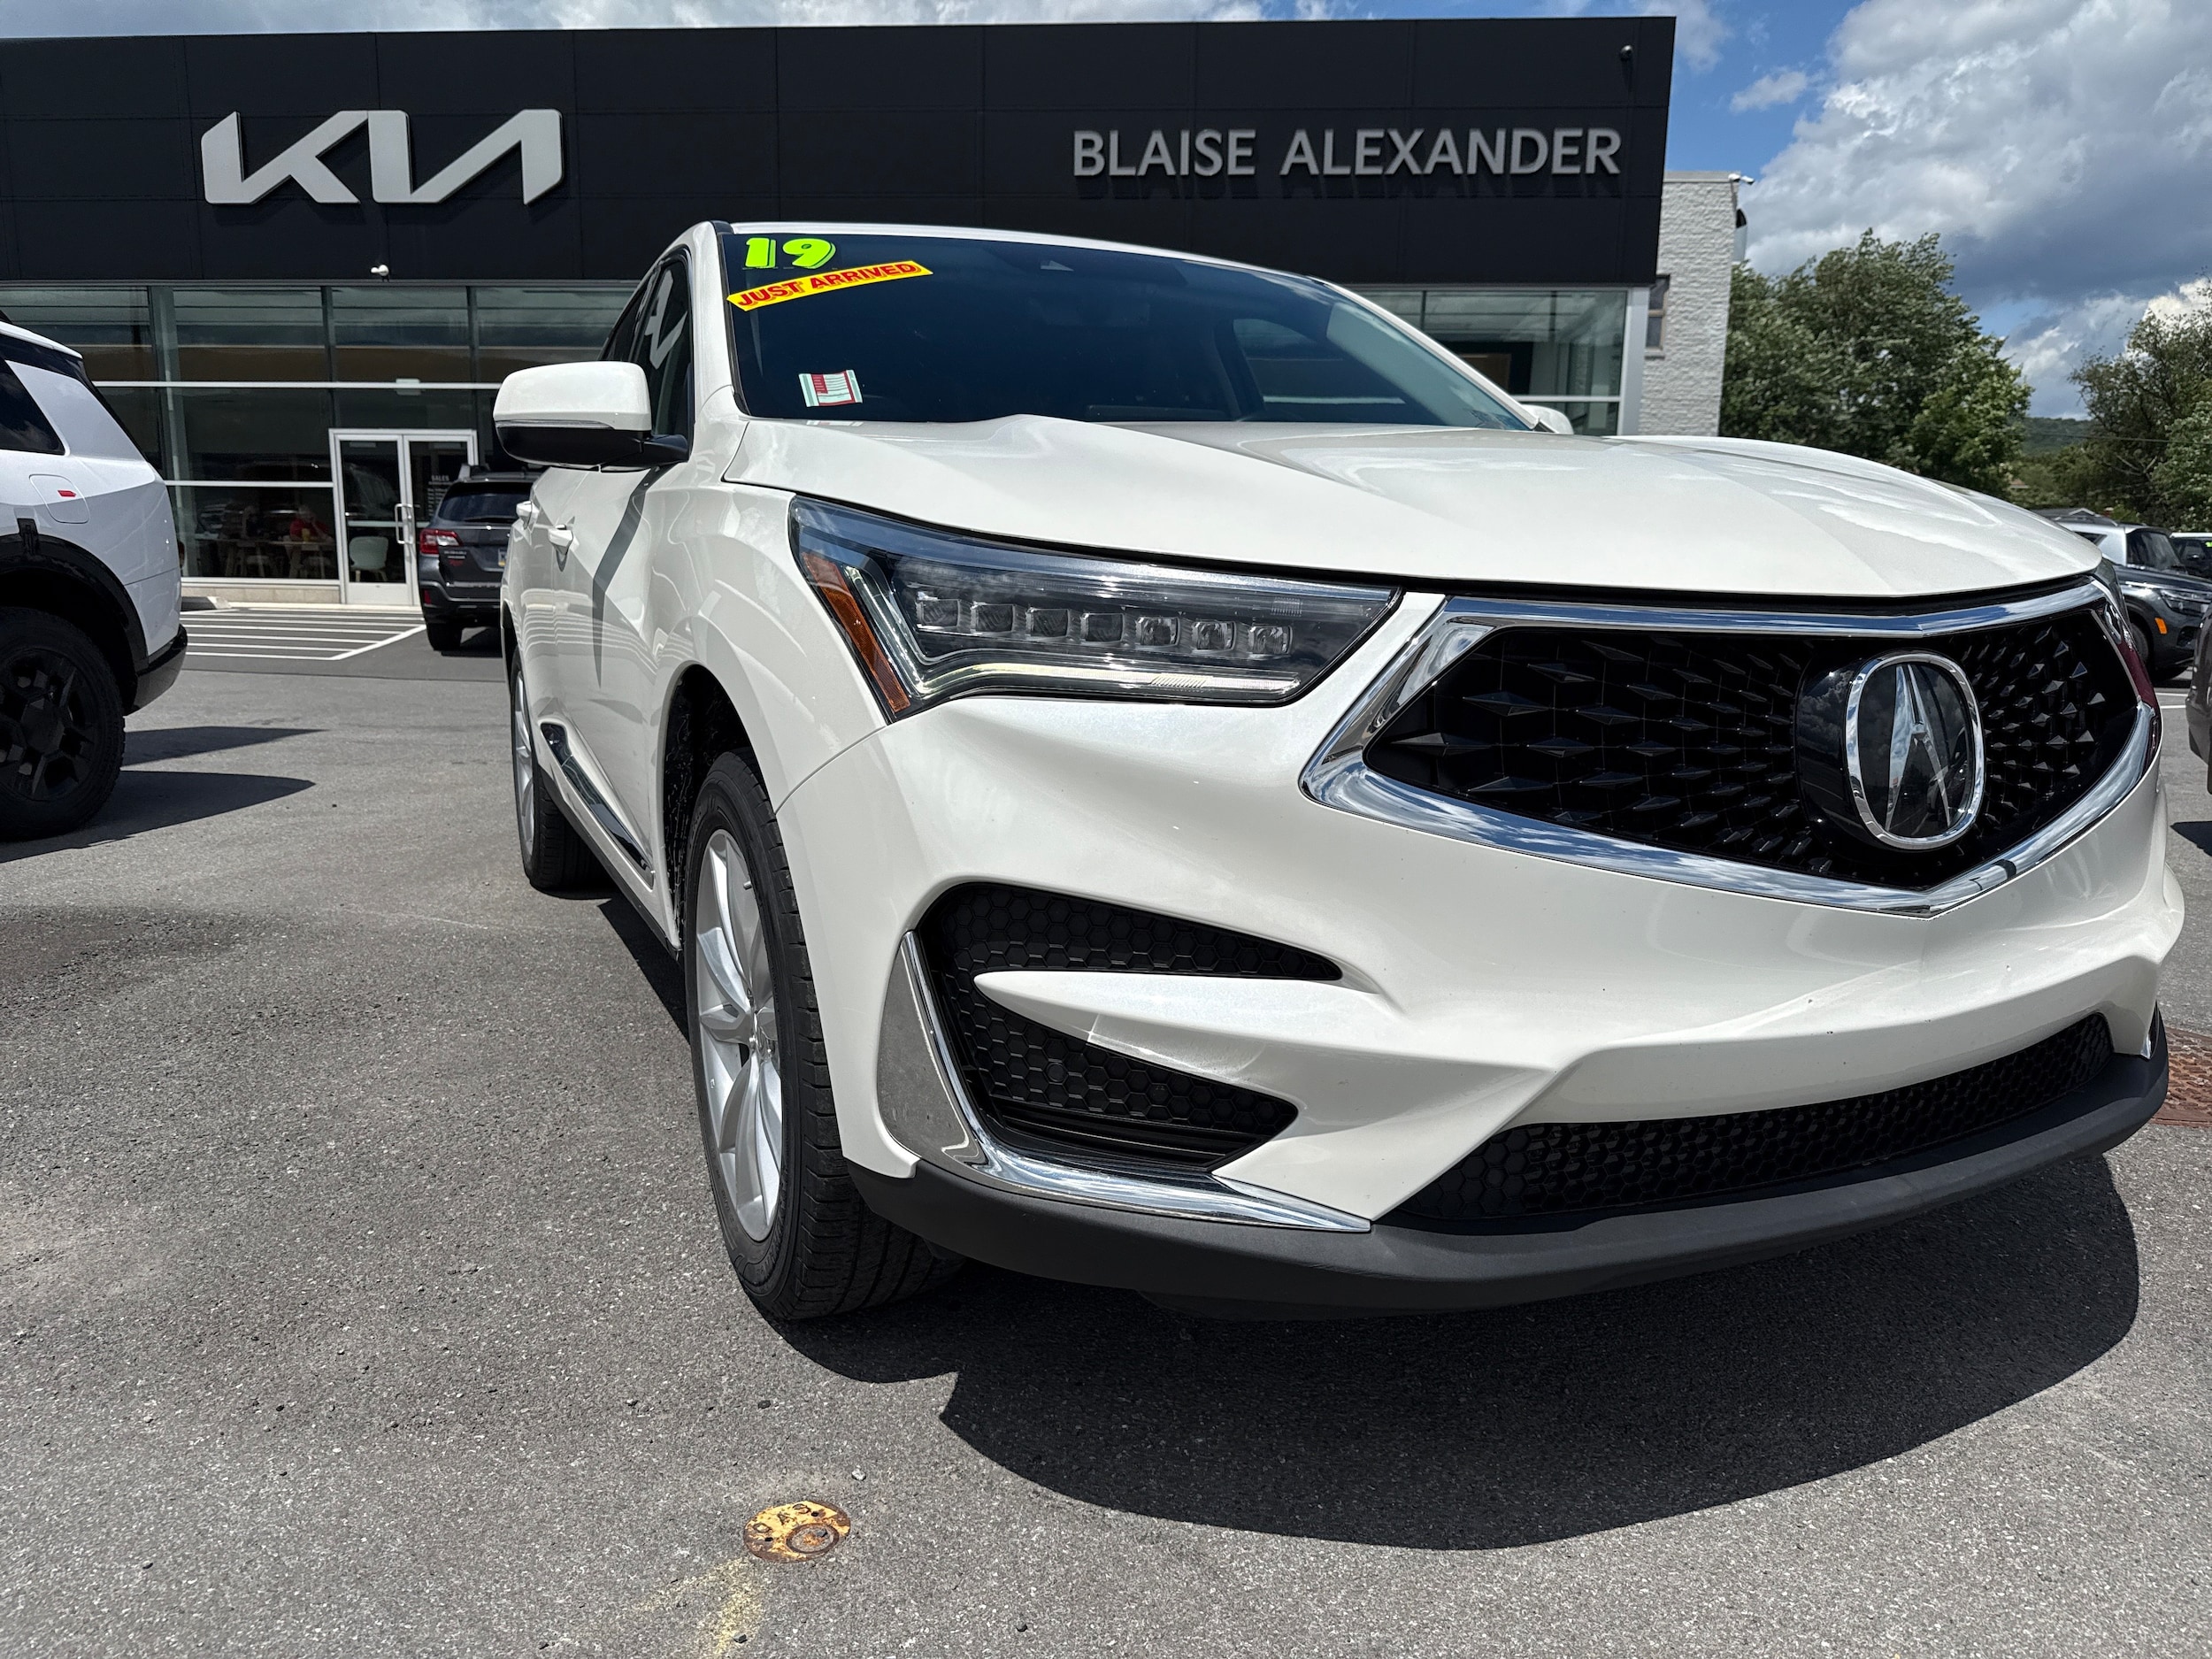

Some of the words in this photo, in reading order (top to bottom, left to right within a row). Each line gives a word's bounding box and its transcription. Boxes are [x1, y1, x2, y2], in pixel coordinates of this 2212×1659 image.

[201, 109, 563, 204] KIA
[1074, 129, 1256, 176] BLAISE
[1279, 128, 1622, 175] ALEXANDER
[745, 237, 835, 269] 19
[738, 280, 803, 306] JUST
[810, 263, 921, 288] ARRIVED
